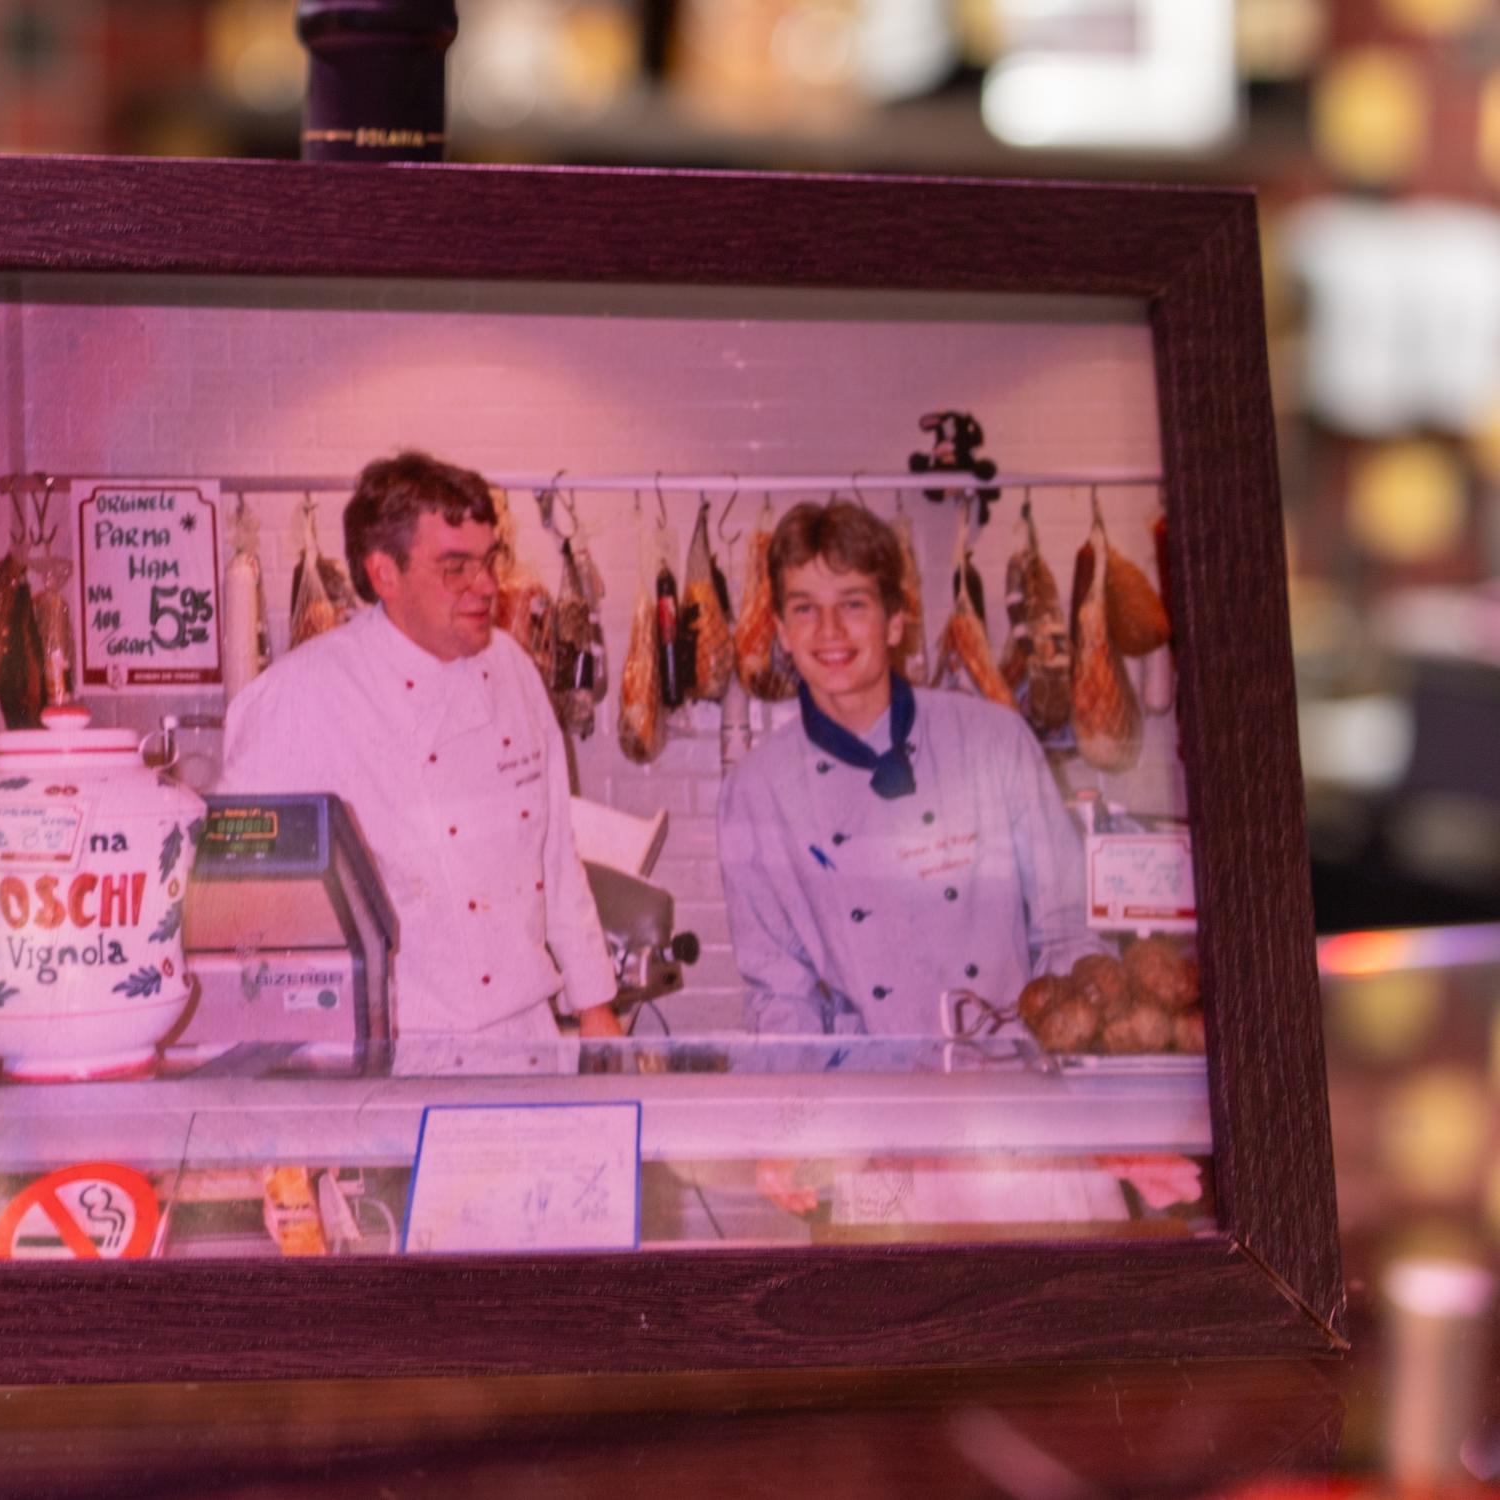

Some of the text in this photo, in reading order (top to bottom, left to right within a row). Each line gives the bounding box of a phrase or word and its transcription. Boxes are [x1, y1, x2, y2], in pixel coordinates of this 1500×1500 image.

[95, 519, 171, 550] PARMA
[128, 554, 180, 581] HAM
[106, 635, 155, 657] GRAM
[7, 935, 128, 985] Vignola
